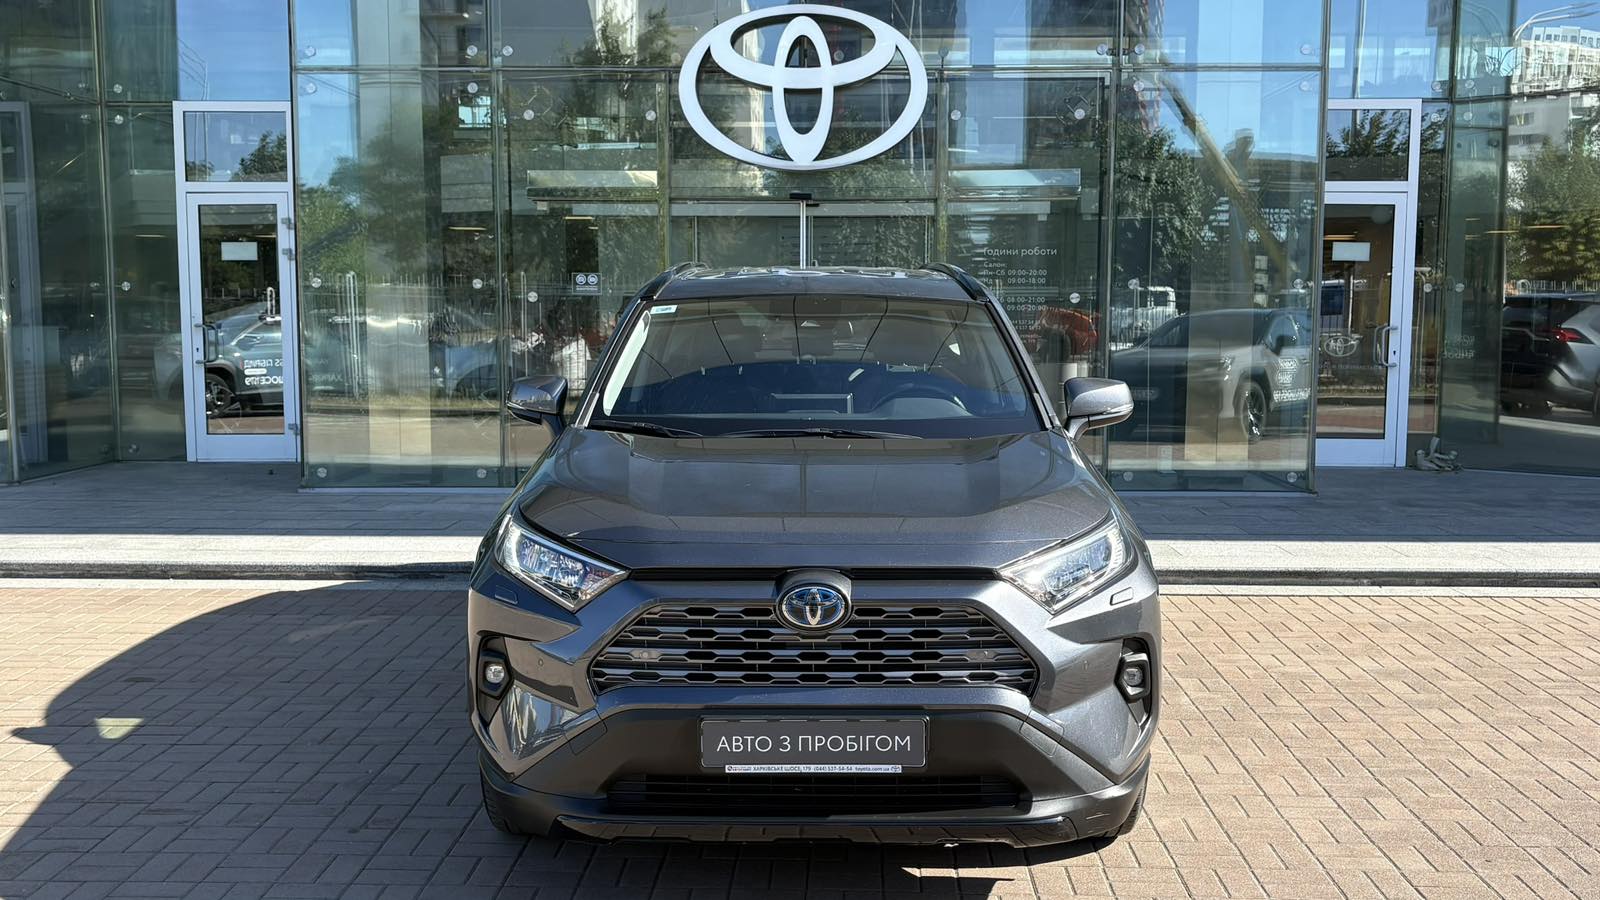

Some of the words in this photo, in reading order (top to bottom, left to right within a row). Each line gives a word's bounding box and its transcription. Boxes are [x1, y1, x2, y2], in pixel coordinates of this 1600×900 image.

[983, 247, 1019, 257] Години
[1021, 246, 1057, 257] роботи
[716, 735, 772, 752] АВТО
[798, 735, 911, 752] ПРОБІГОМ
